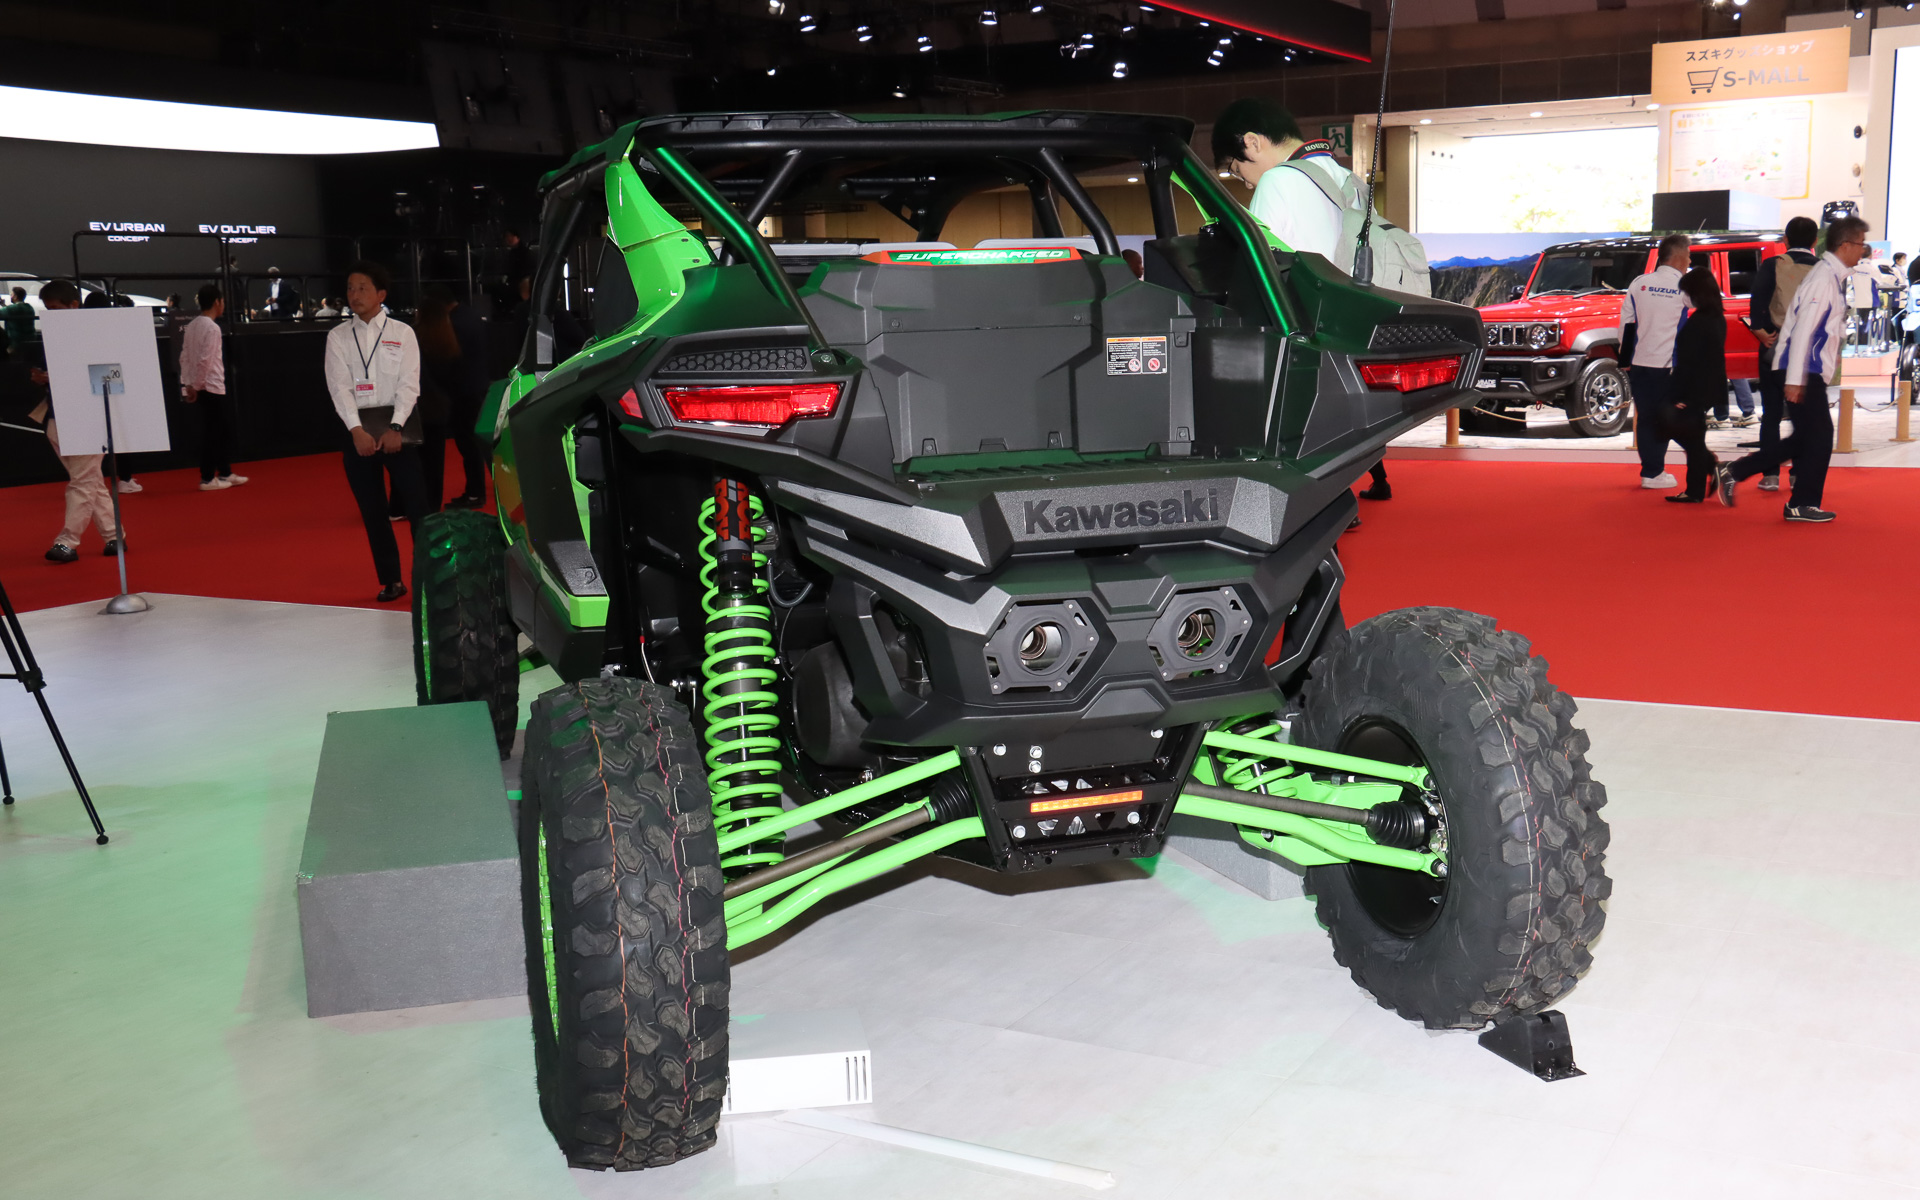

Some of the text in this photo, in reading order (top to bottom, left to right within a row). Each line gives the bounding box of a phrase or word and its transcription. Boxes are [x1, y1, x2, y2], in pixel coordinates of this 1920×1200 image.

[1686, 40, 1816, 62] スズキグッズショップ
[1723, 65, 1810, 88] S-MALL
[1305, 143, 1329, 151] Canon
[89, 221, 165, 232] EV URBAN
[199, 224, 276, 234] EV OUTLIER
[896, 250, 1065, 261] SUPERCHARGED
[1649, 287, 1681, 295] SUZUKI
[1023, 487, 1219, 535] Kawasaki
